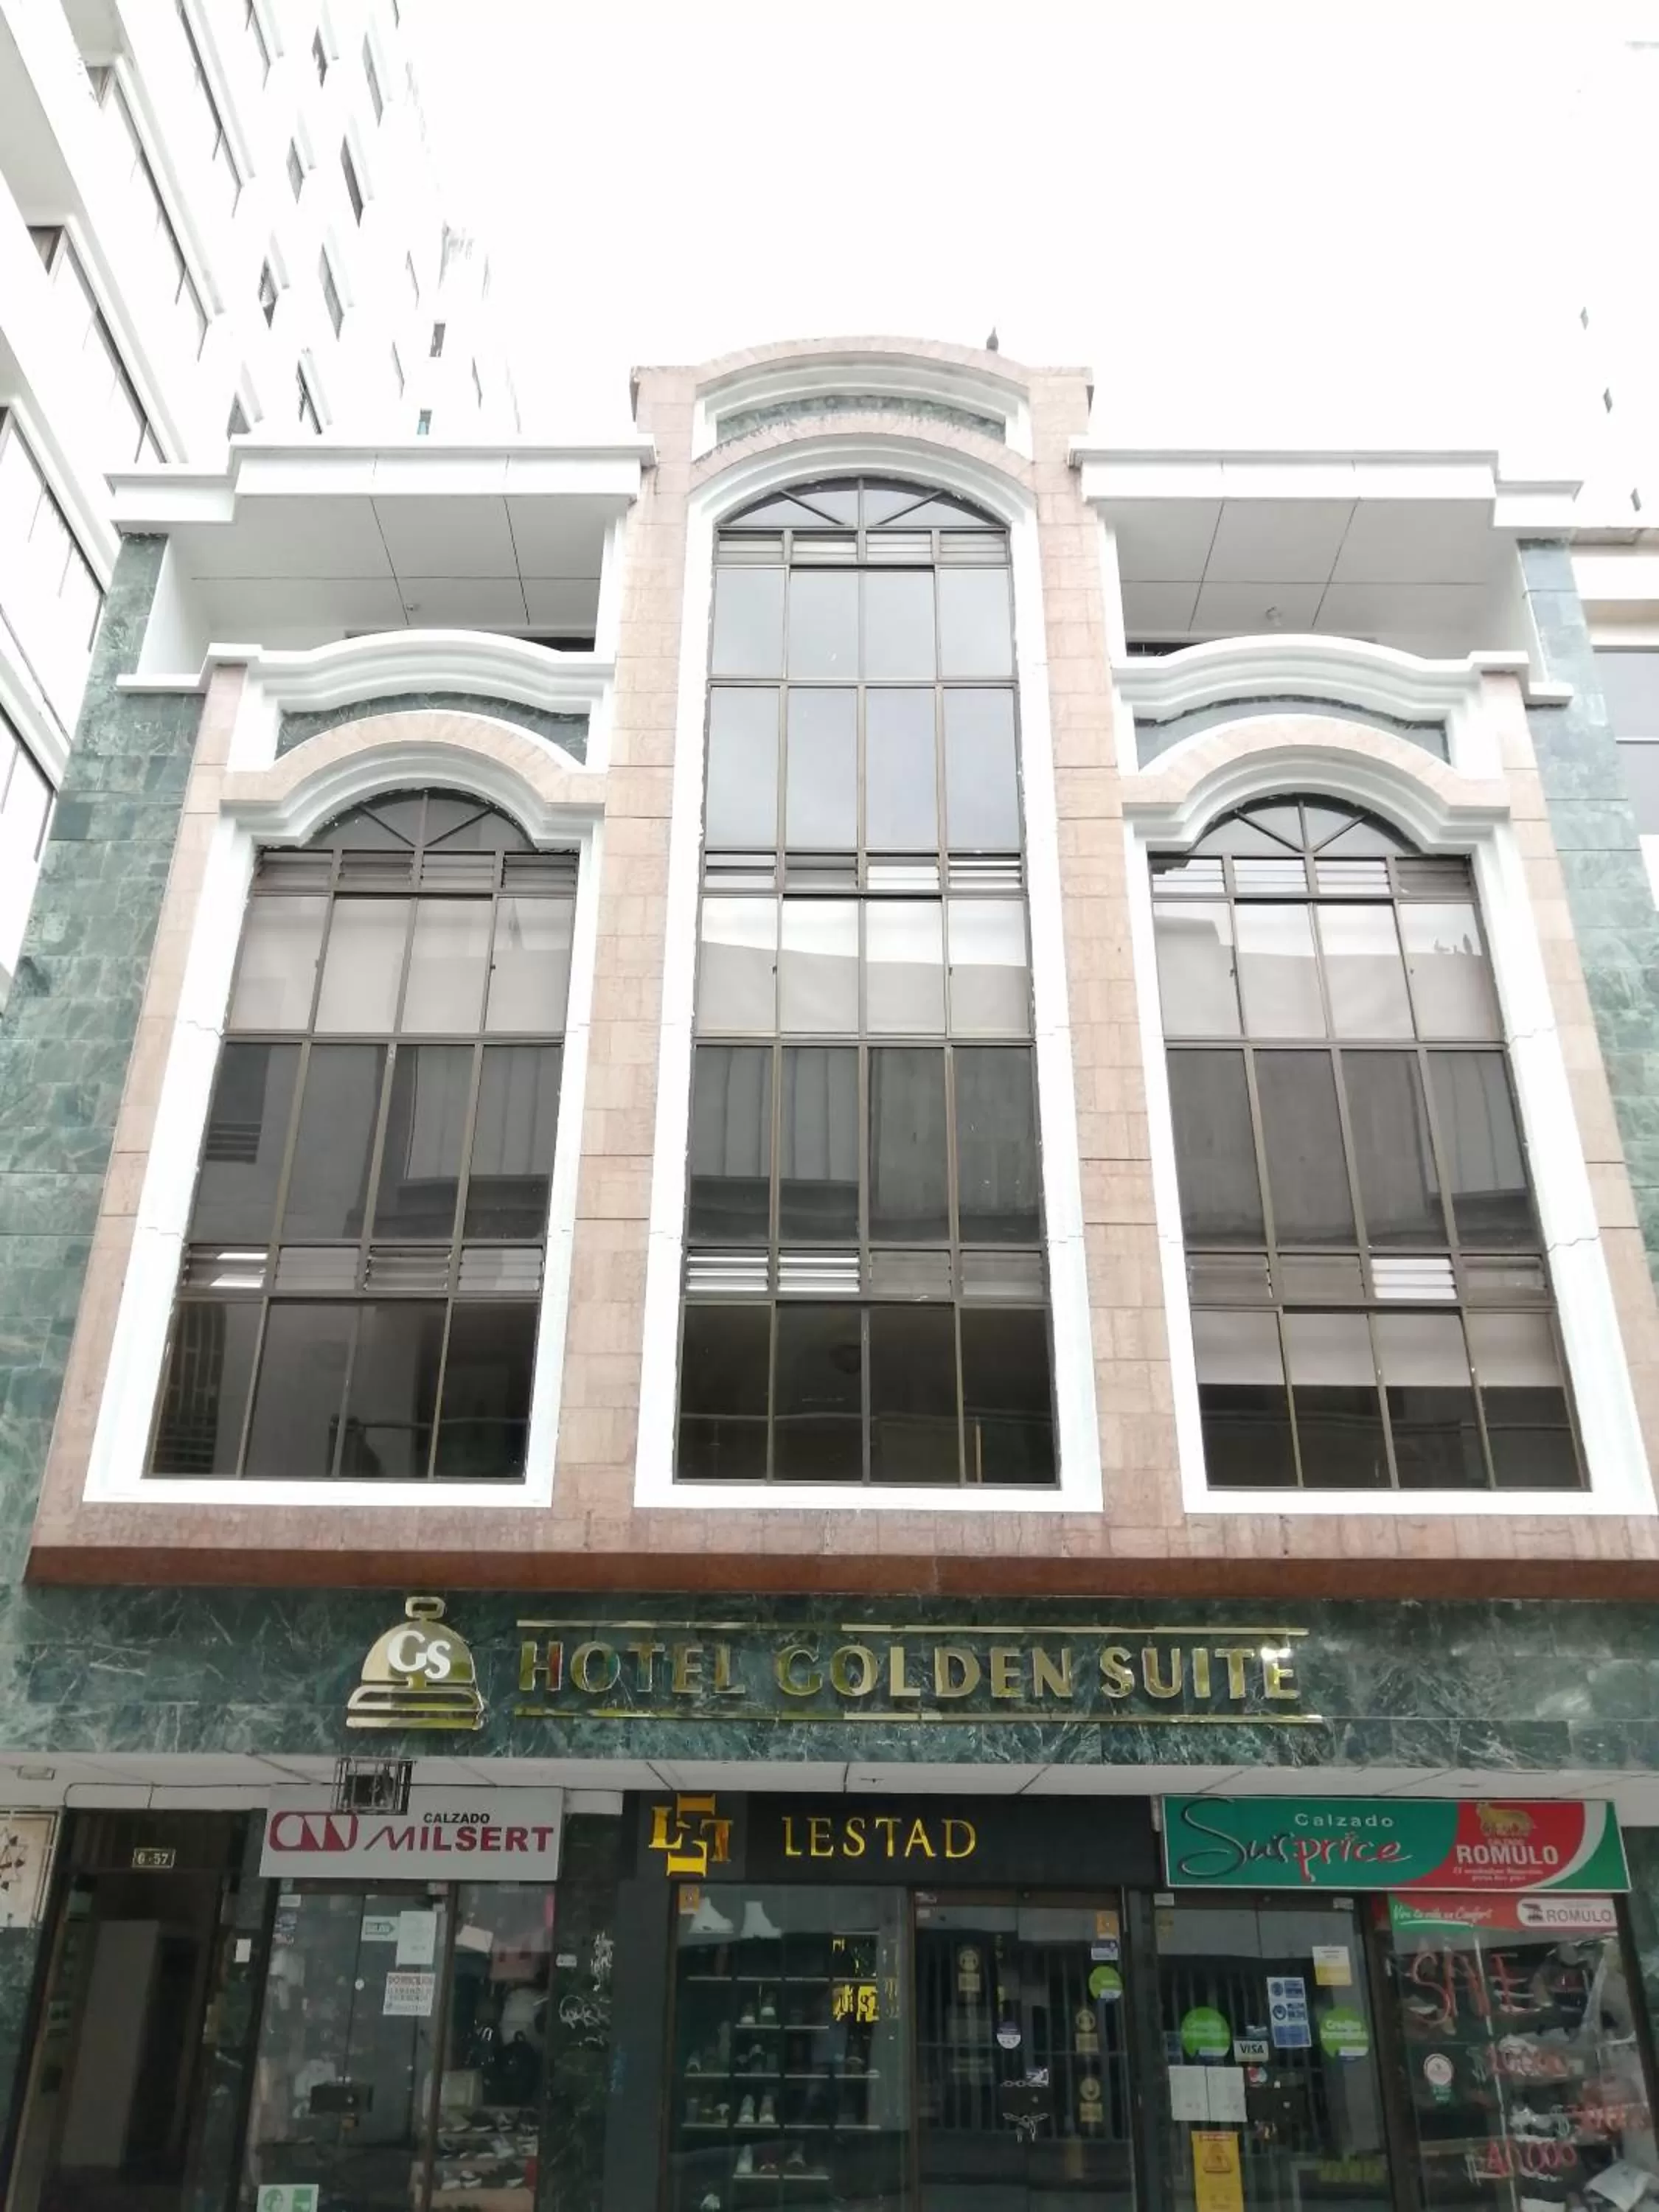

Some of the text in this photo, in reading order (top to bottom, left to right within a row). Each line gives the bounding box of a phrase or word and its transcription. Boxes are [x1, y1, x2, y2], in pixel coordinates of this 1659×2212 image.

[519, 1640, 1300, 1700] HOTEL GOLDEN SUITE
[423, 1812, 490, 1823] CALZADO
[1294, 1813, 1395, 1828] Calzado
[364, 1826, 554, 1852] MILSERT
[782, 1816, 978, 1857] LESTAD
[1456, 1845, 1559, 1865] ROMULO
[1546, 1908, 1613, 1923] ROMULO
[1240, 2043, 1265, 2054] VISA
